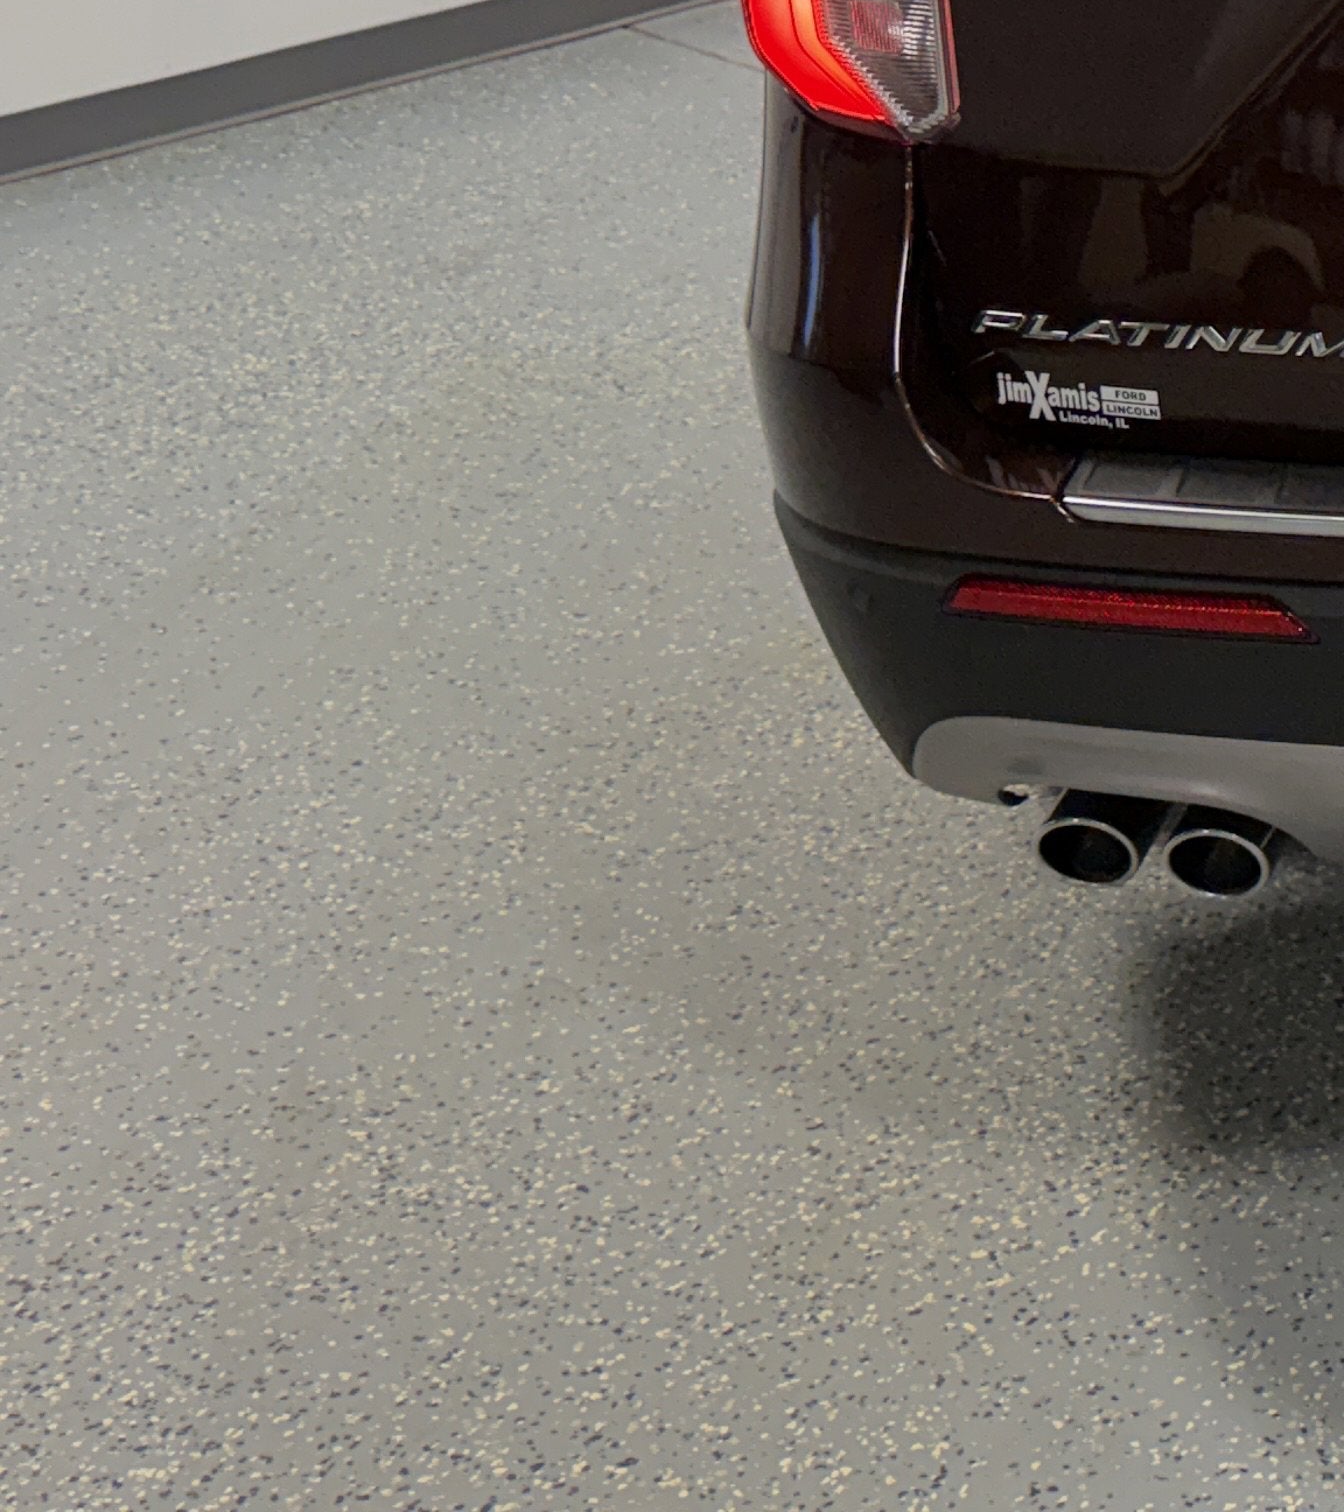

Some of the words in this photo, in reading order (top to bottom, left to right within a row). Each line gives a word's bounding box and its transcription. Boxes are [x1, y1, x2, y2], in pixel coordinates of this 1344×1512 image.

[1114, 390, 1147, 402] FORD
[1105, 404, 1159, 418] LINCOLN
[1058, 411, 1113, 427] Lincoln,
[1116, 417, 1130, 429] IL
